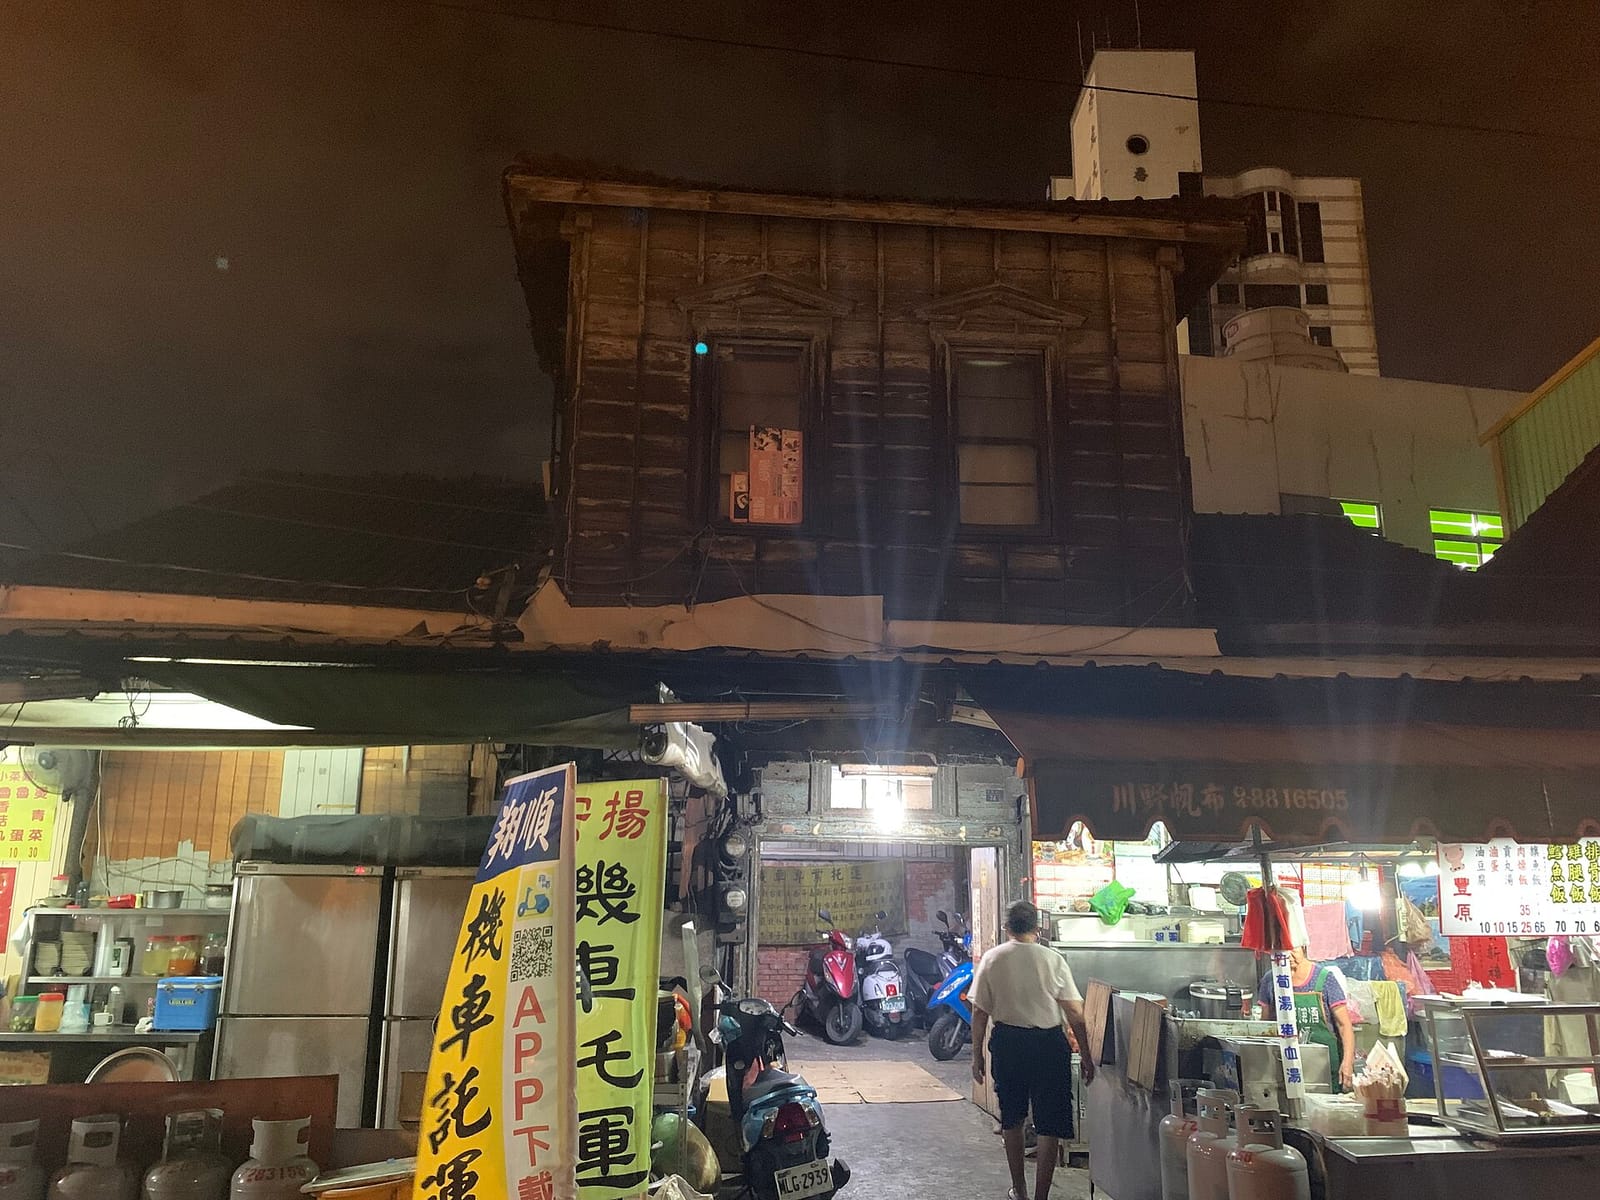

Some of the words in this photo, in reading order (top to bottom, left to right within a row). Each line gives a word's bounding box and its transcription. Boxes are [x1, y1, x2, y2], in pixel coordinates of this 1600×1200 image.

[9, 847, 19, 859] 10
[28, 847, 38, 859] 30
[1479, 922, 1491, 933] 10
[1494, 922, 1505, 933] 10
[1507, 922, 1518, 933] 15
[1521, 922, 1532, 933] 25
[1534, 922, 1546, 933] 65
[1555, 921, 1567, 932] 70
[1574, 921, 1586, 932] 70
